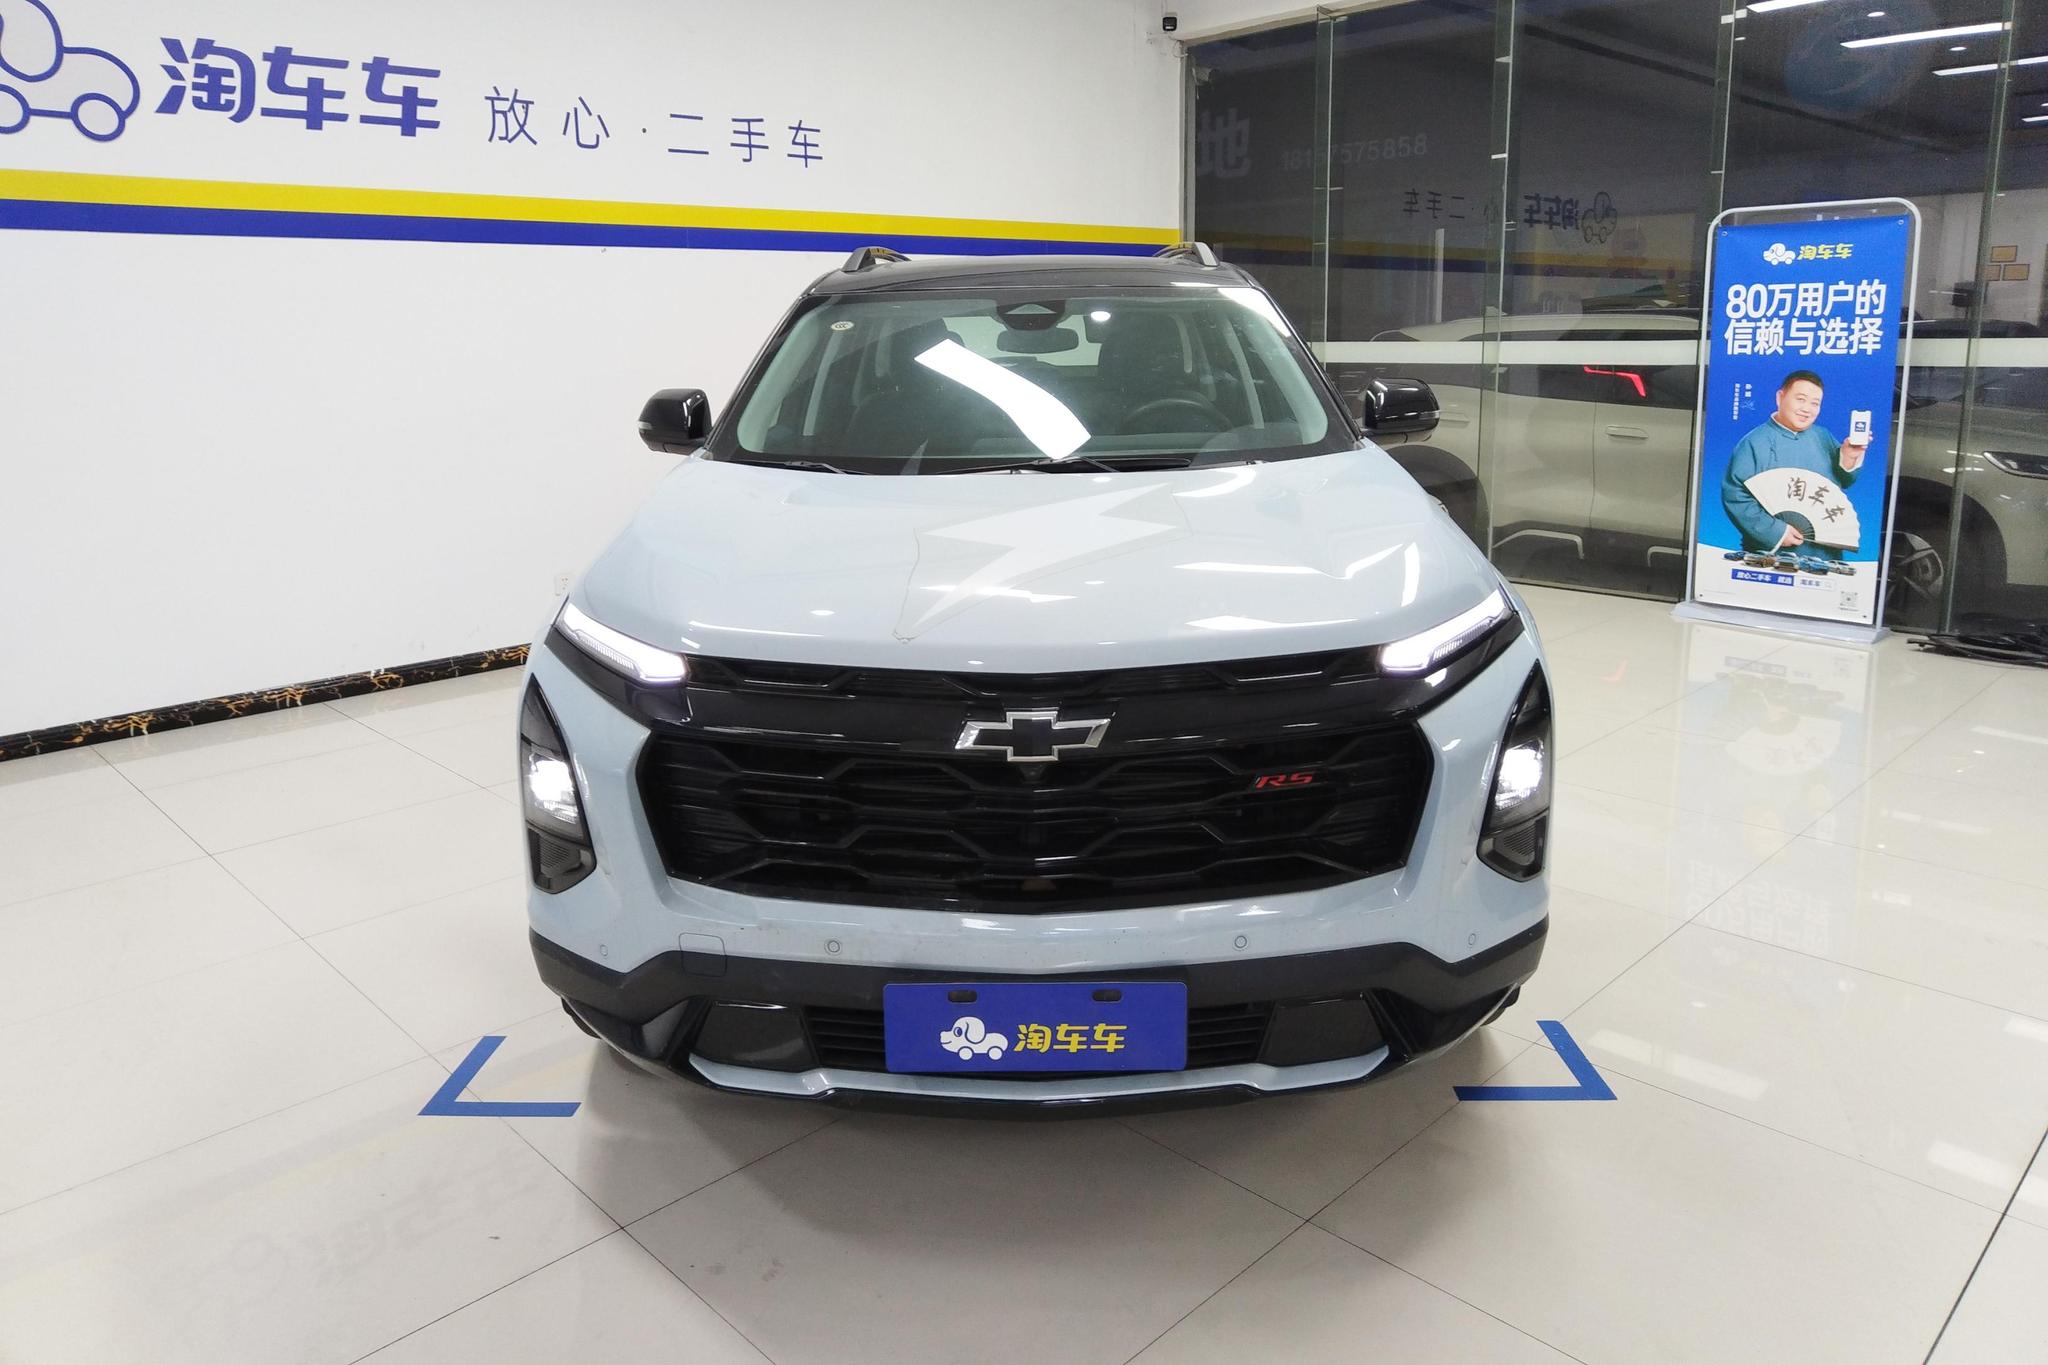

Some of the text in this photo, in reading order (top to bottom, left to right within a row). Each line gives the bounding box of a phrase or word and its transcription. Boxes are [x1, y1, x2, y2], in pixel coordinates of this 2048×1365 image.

[155, 37, 441, 137] 淘车车
[1797, 243, 1854, 261] 淘车车
[1725, 278, 1887, 319] 80万用户的
[1724, 317, 1884, 355] 信赖与选择
[1787, 477, 1845, 523] 淘车车
[1256, 772, 1314, 789] RS
[1013, 1022, 1128, 1053] 淘车车
